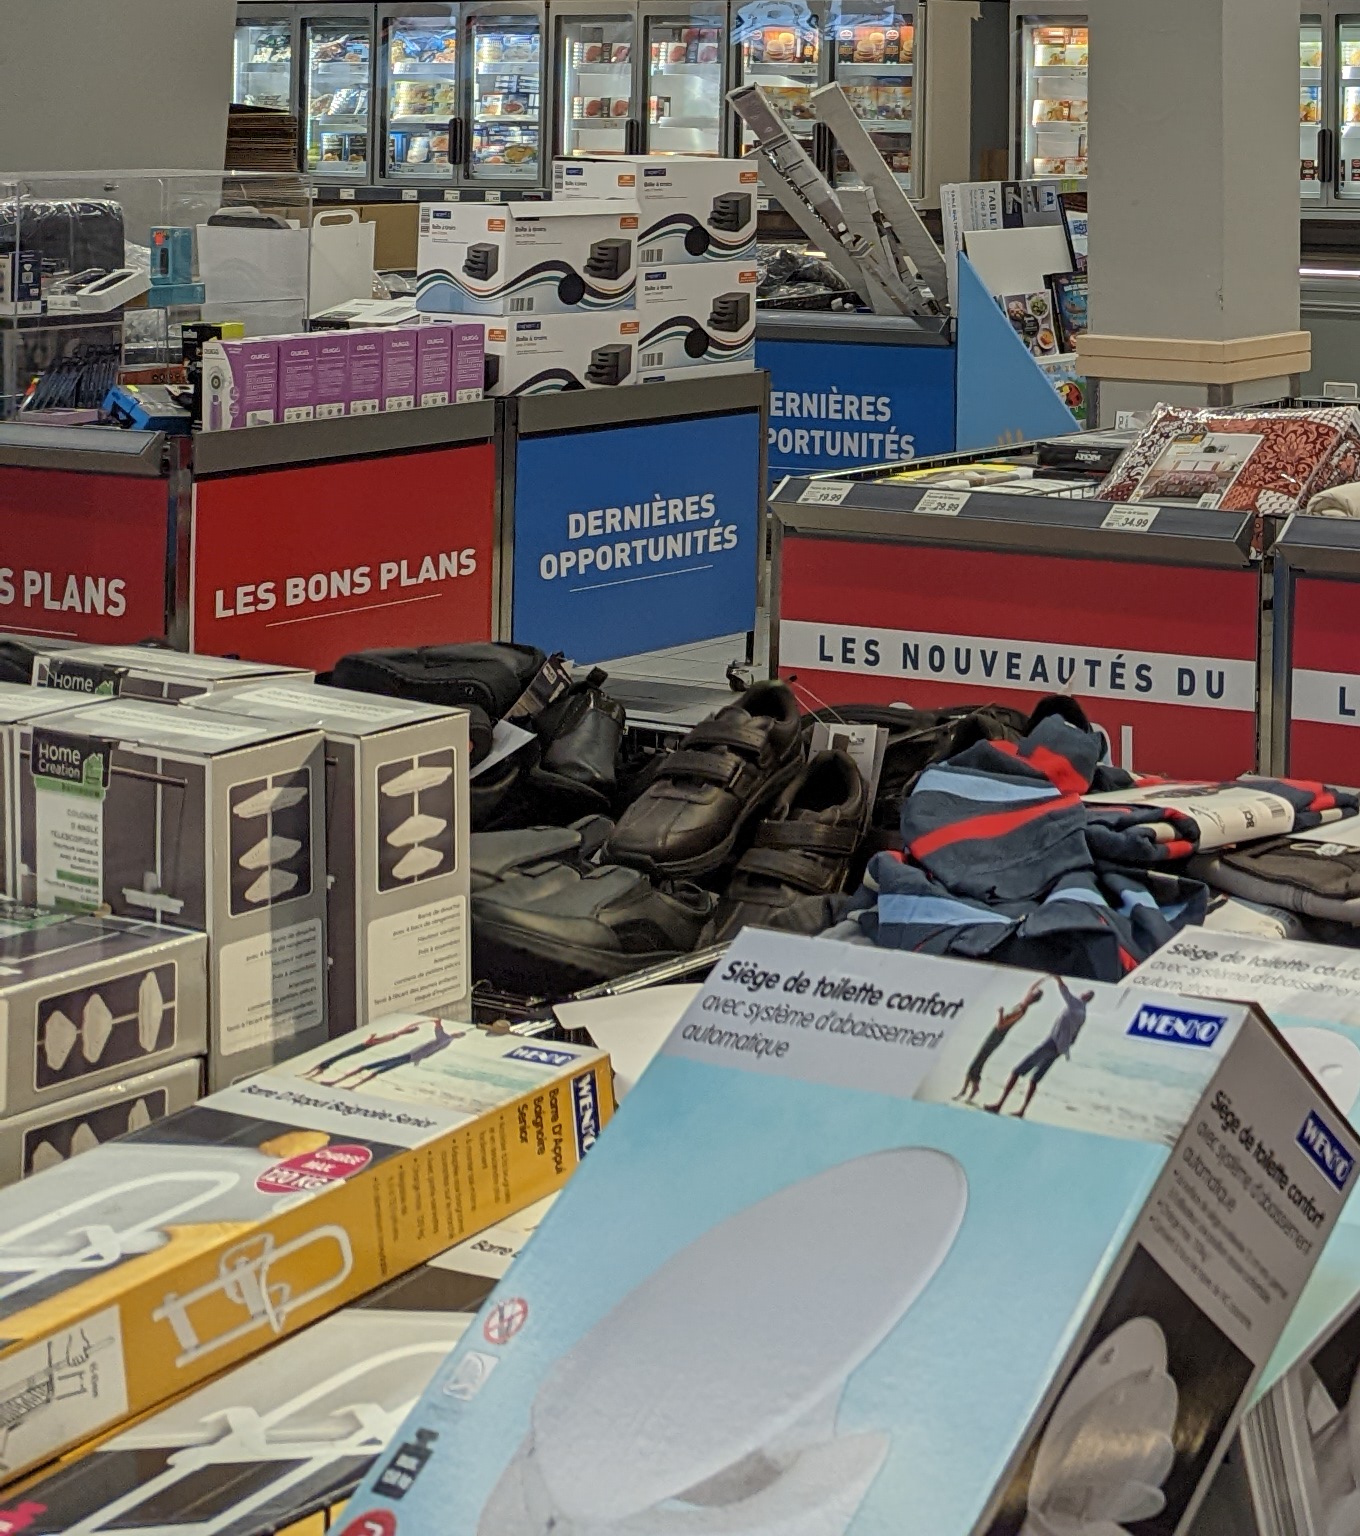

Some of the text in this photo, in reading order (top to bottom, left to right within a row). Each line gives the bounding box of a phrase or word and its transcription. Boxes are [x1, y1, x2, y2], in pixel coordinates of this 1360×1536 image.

[769, 384, 892, 422] ERNIÈRES
[768, 426, 915, 460] PORTUNITÉS
[567, 492, 715, 541] DERNIÈRES
[1121, 517, 1149, 528] 34.99
[539, 519, 740, 582] OPPORTUNITÉS
[23, 570, 127, 618] PLANS
[214, 547, 477, 619] LES BONS PLANS
[53, 673, 93, 692] Home
[818, 634, 1225, 700] LES NOUVEAUTÉS DU
[38, 760, 81, 780] Creation
[39, 742, 81, 765] Home
[1166, 942, 1219, 962] Siège
[1221, 949, 1246, 964] de
[1247, 953, 1311, 972] toilette
[721, 959, 965, 1020] Siège de toilette confort
[681, 1021, 790, 1059] automatique
[701, 993, 945, 1050] avec système d'abaissement
[1134, 1008, 1225, 1045] WENKO
[518, 1103, 529, 1145] Senior
[533, 1095, 546, 1156] Baignoire
[548, 1088, 567, 1175] Barre D'Appui
[1210, 1089, 1327, 1230] Siège de toilette confort
[1302, 1117, 1352, 1182] WENKO
